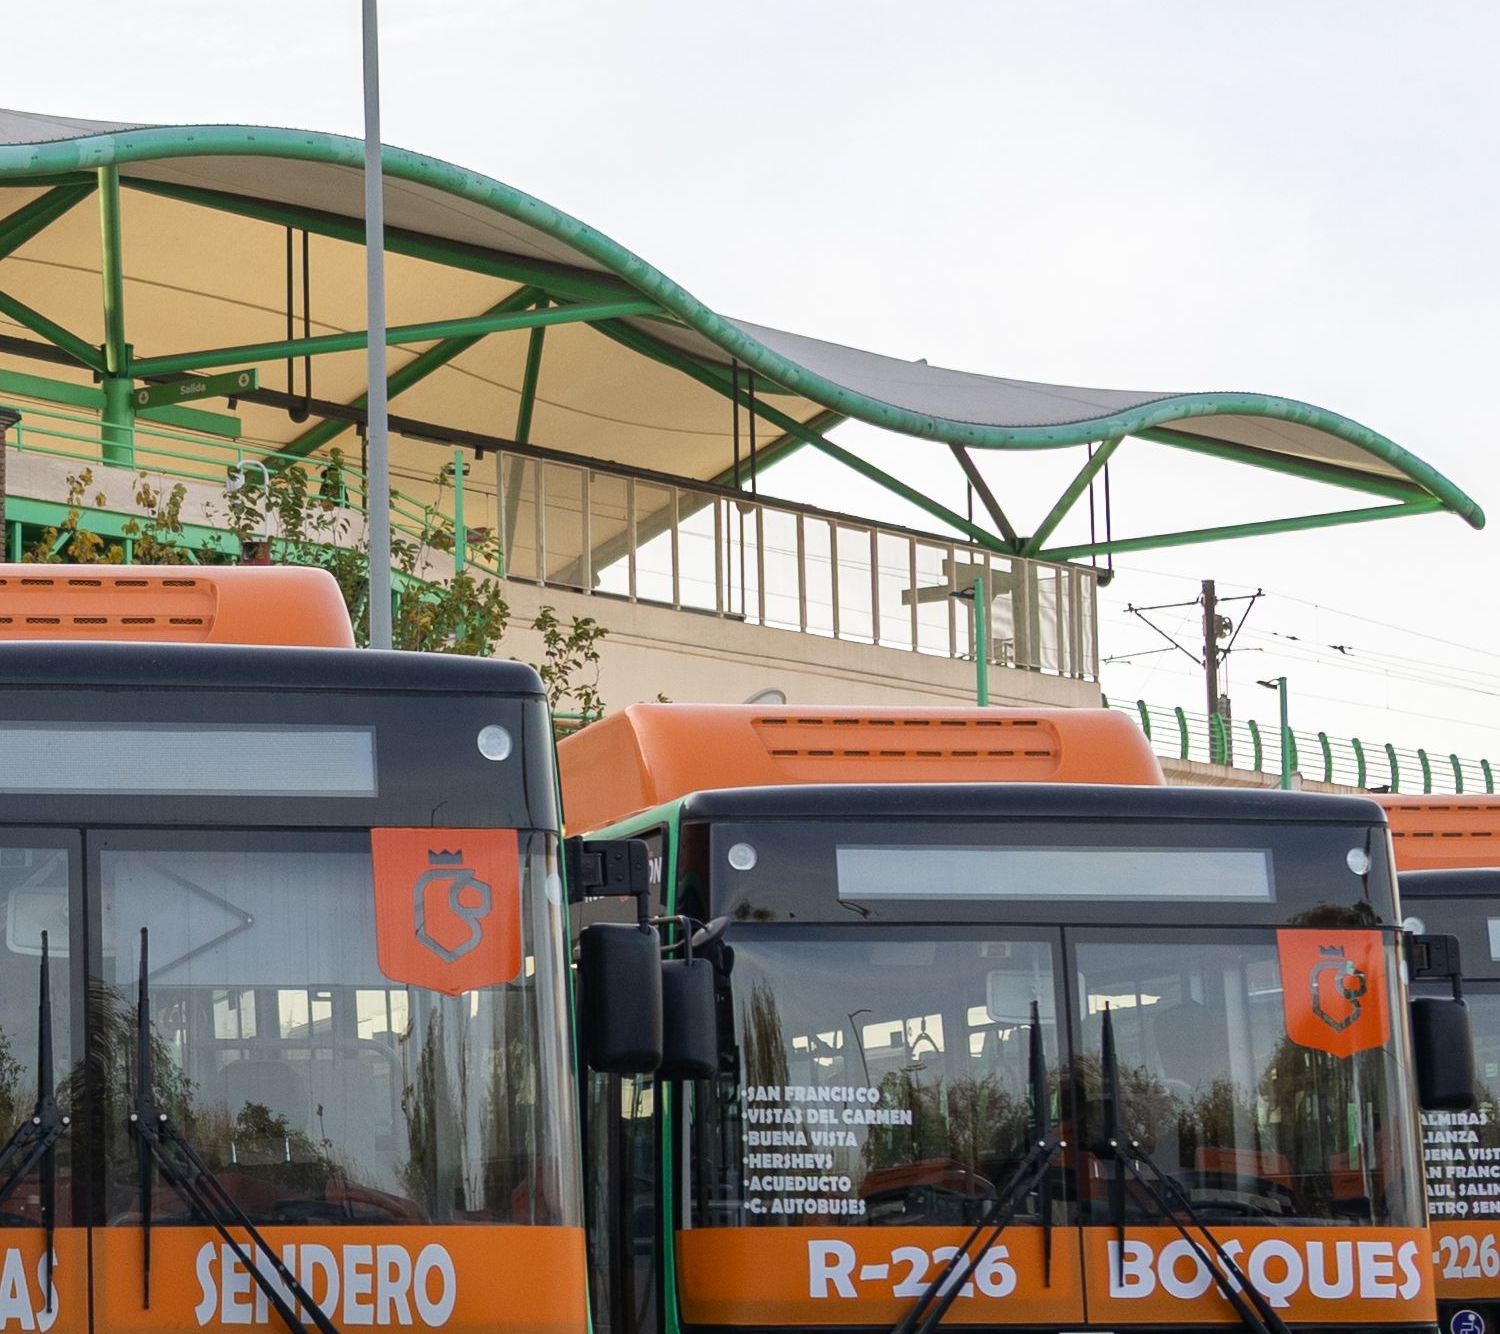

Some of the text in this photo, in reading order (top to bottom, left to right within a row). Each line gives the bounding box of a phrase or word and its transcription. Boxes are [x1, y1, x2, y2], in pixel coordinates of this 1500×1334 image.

[180, 382, 206, 396] Salida
[747, 1085, 880, 1104] SAN FRANCISCO
[747, 1108, 913, 1126] VISTAS DEL CARMEN
[1420, 1112, 1488, 1126] ALMIRAS
[748, 1130, 859, 1147] BUENA VISTA
[748, 1153, 834, 1171] HERSHEYS
[749, 1175, 852, 1192] ACUEDUCTO
[749, 1197, 867, 1216] C. AUTOBUSES
[1429, 1201, 1469, 1215] ETRO
[807, 1239, 1017, 1299] R-226
[194, 1241, 457, 1328] SENDERO
